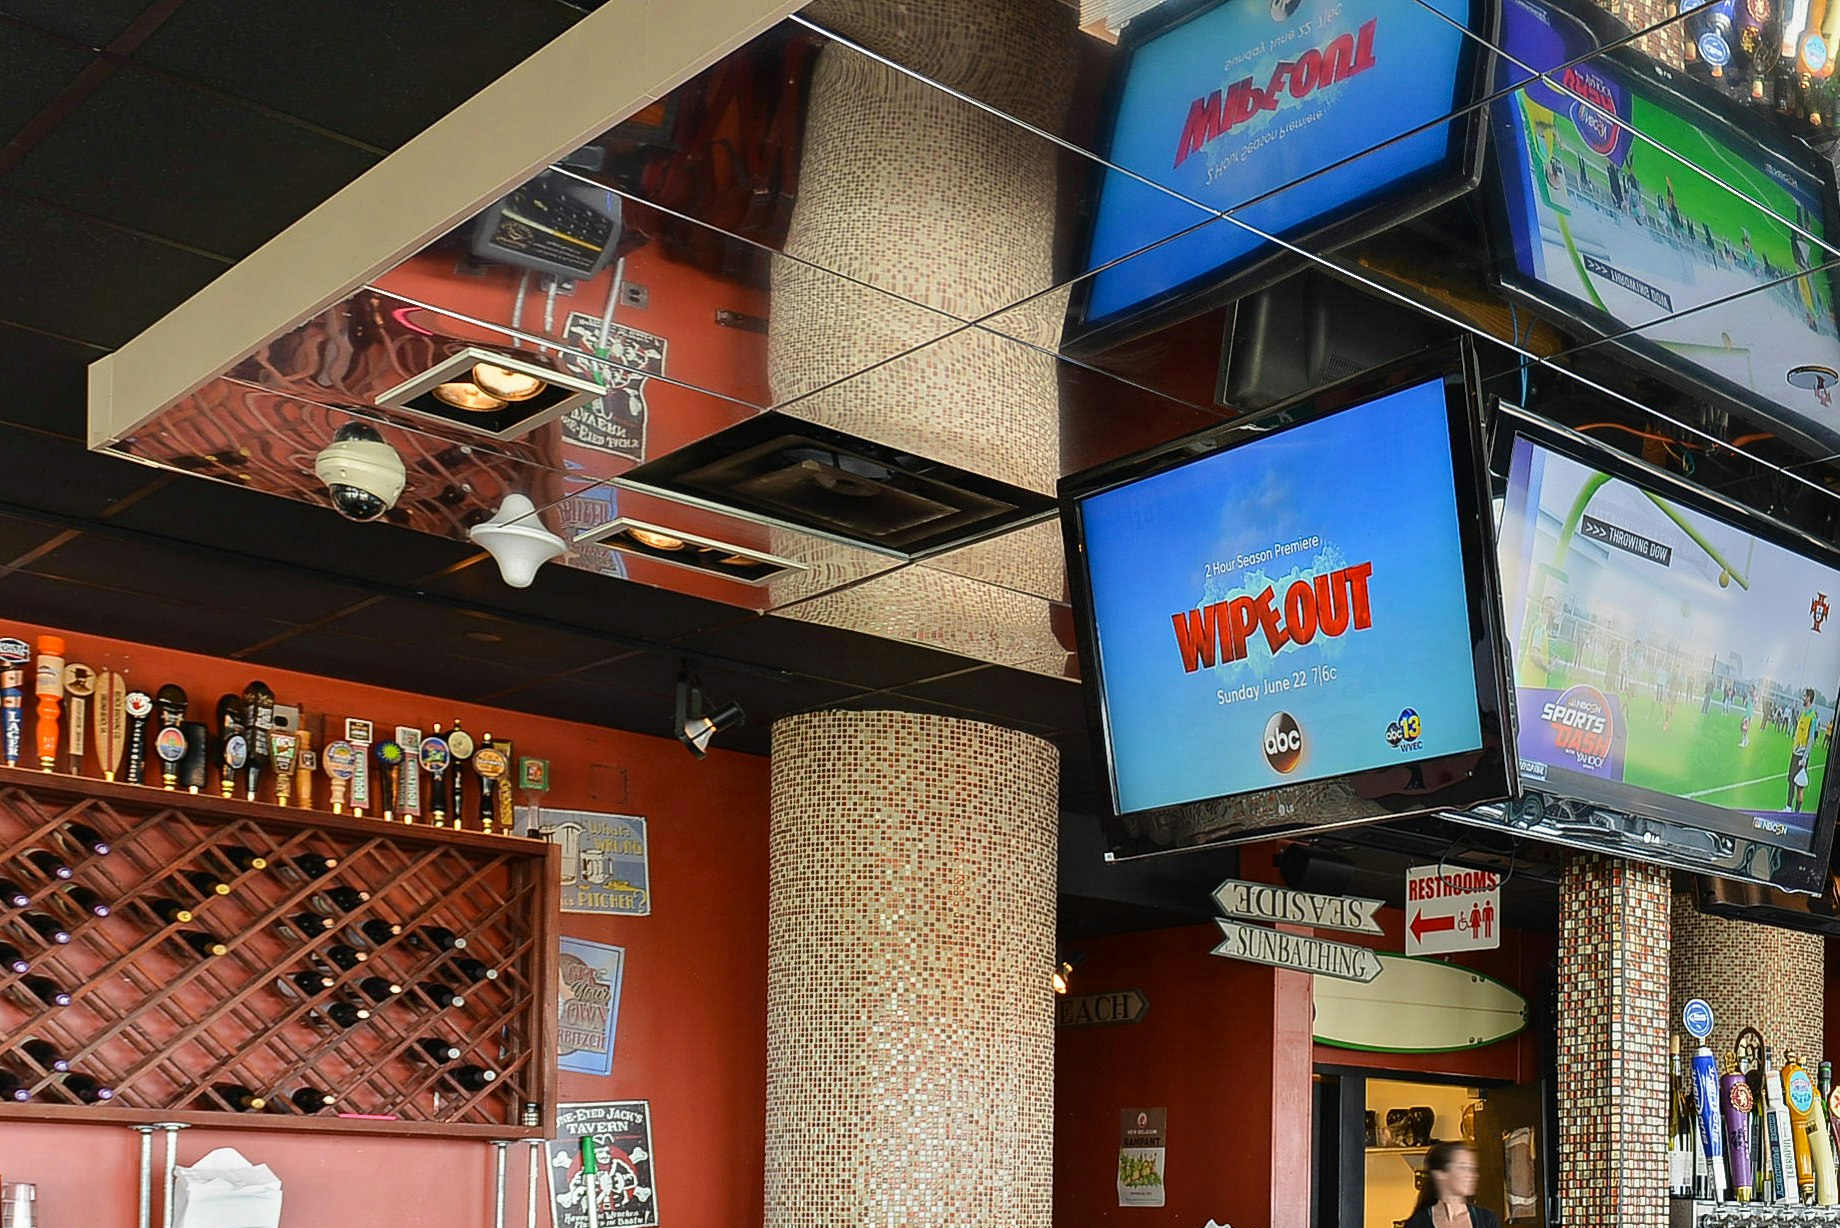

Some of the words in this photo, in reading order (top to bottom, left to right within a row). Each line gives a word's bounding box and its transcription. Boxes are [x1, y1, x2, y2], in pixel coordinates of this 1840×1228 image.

[1204, 563, 1212, 579] 2
[1213, 558, 1235, 577] Hour
[1237, 547, 1273, 569] Season
[1274, 534, 1319, 560] Premiere
[1609, 526, 1649, 555] THROWING
[1650, 545, 1669, 562] DOW
[1171, 562, 1373, 675] WIPEOUT
[1217, 683, 1260, 705] Sunday
[1263, 676, 1290, 696] June
[1292, 672, 1307, 689] 22
[1386, 728, 1403, 741] abc
[1400, 715, 1421, 739] 13
[1541, 702, 1607, 734] SPORTS
[6, 711, 21, 757] LAGER
[1265, 726, 1301, 755] abc
[1400, 741, 1423, 752] WVEC
[577, 889, 648, 913] PITCHER?
[1408, 870, 1497, 902] RESTROOMS
[1233, 884, 1363, 929] SEASIDE
[1236, 926, 1367, 978] SUNBATHING
[571, 981, 611, 1001] Your
[565, 1001, 610, 1029] OWN
[1058, 994, 1130, 1024] EACH
[566, 1121, 629, 1134] TAVERN
[606, 1108, 644, 1123] JACK'S
[1124, 1137, 1160, 1148] RAMPANT
